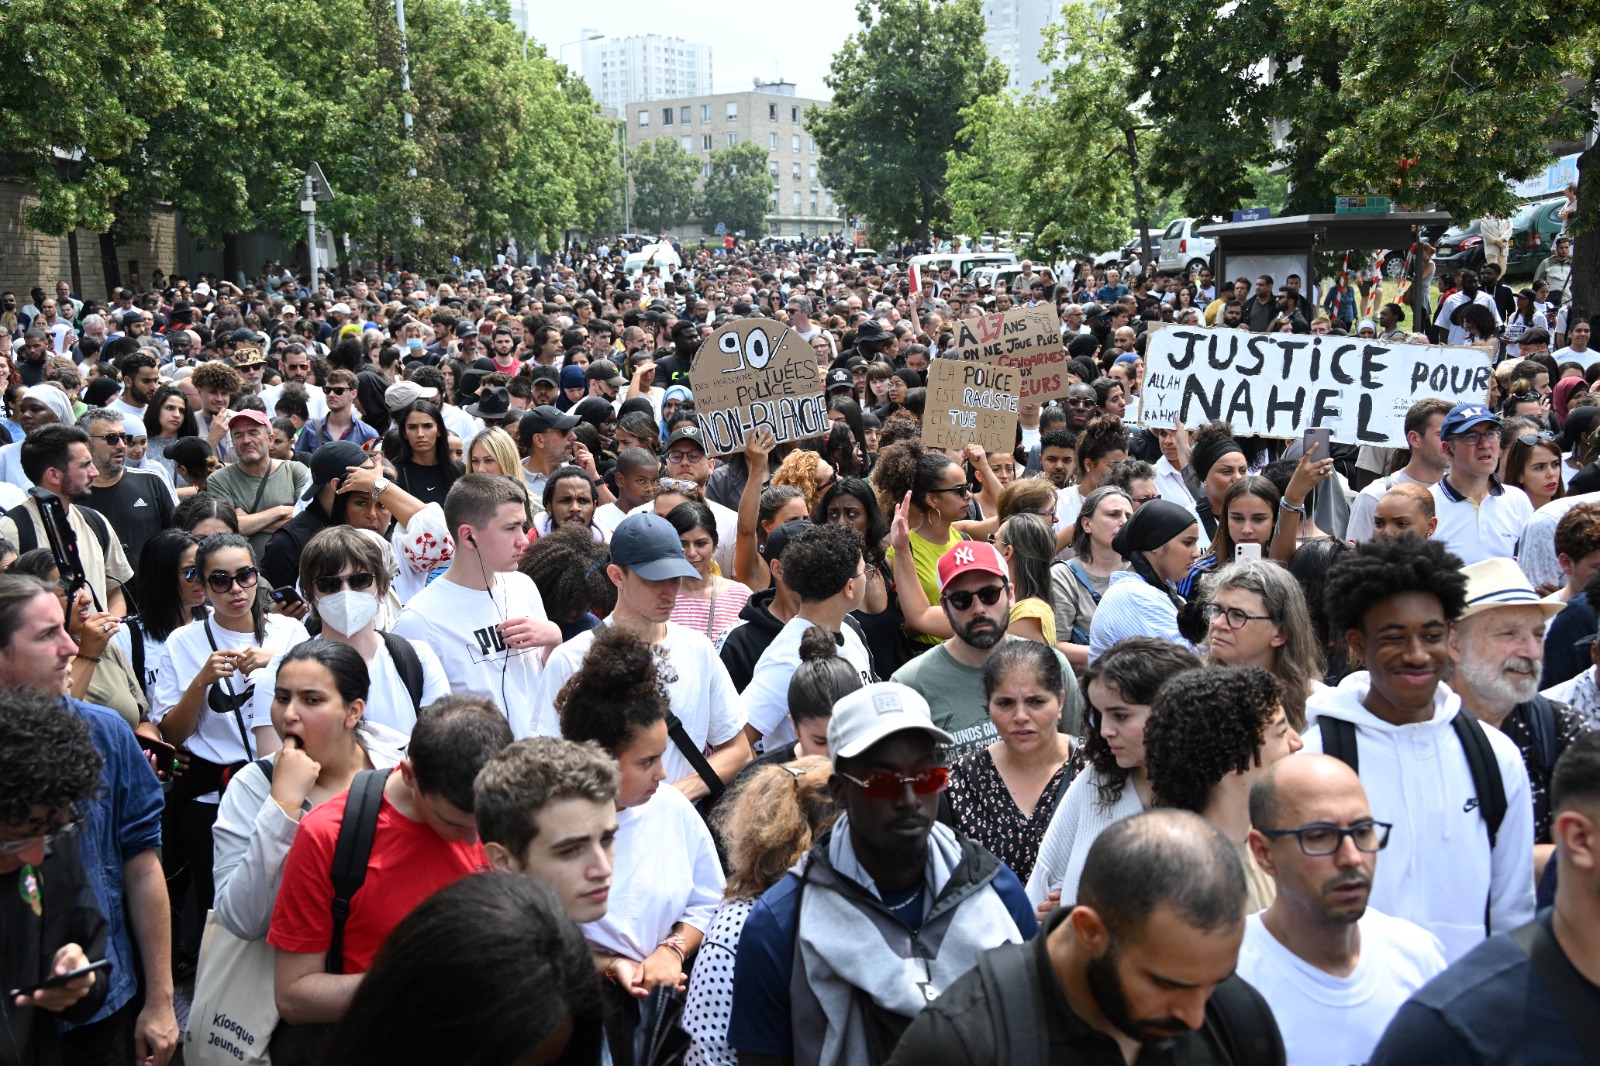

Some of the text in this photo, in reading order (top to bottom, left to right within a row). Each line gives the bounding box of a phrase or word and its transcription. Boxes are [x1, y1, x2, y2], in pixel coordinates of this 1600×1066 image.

[958, 313, 1027, 348] À 17 ANS
[718, 326, 790, 374] 90%
[963, 348, 980, 361] ON
[983, 342, 1004, 357] NE
[1036, 333, 1059, 347] PLUS
[997, 349, 1066, 368] GENDARMES
[759, 357, 817, 385] TUÉES
[938, 362, 955, 382] LA
[1020, 367, 1033, 377] UX
[1147, 372, 1181, 390] ALLAH
[1410, 361, 1491, 396] POUR
[935, 387, 958, 403] EST
[1019, 373, 1061, 397] EURS
[1157, 393, 1167, 407] Y
[1180, 373, 1390, 443] NAHEL
[931, 409, 1006, 429] ET TUE DES
[937, 428, 1002, 450] ENFANTS
[954, 545, 975, 566] NY
[473, 623, 512, 656] PU
[941, 726, 983, 748] OUNDS
[212, 1013, 255, 1046] Kiosque
[207, 1031, 245, 1062] Jeunes
